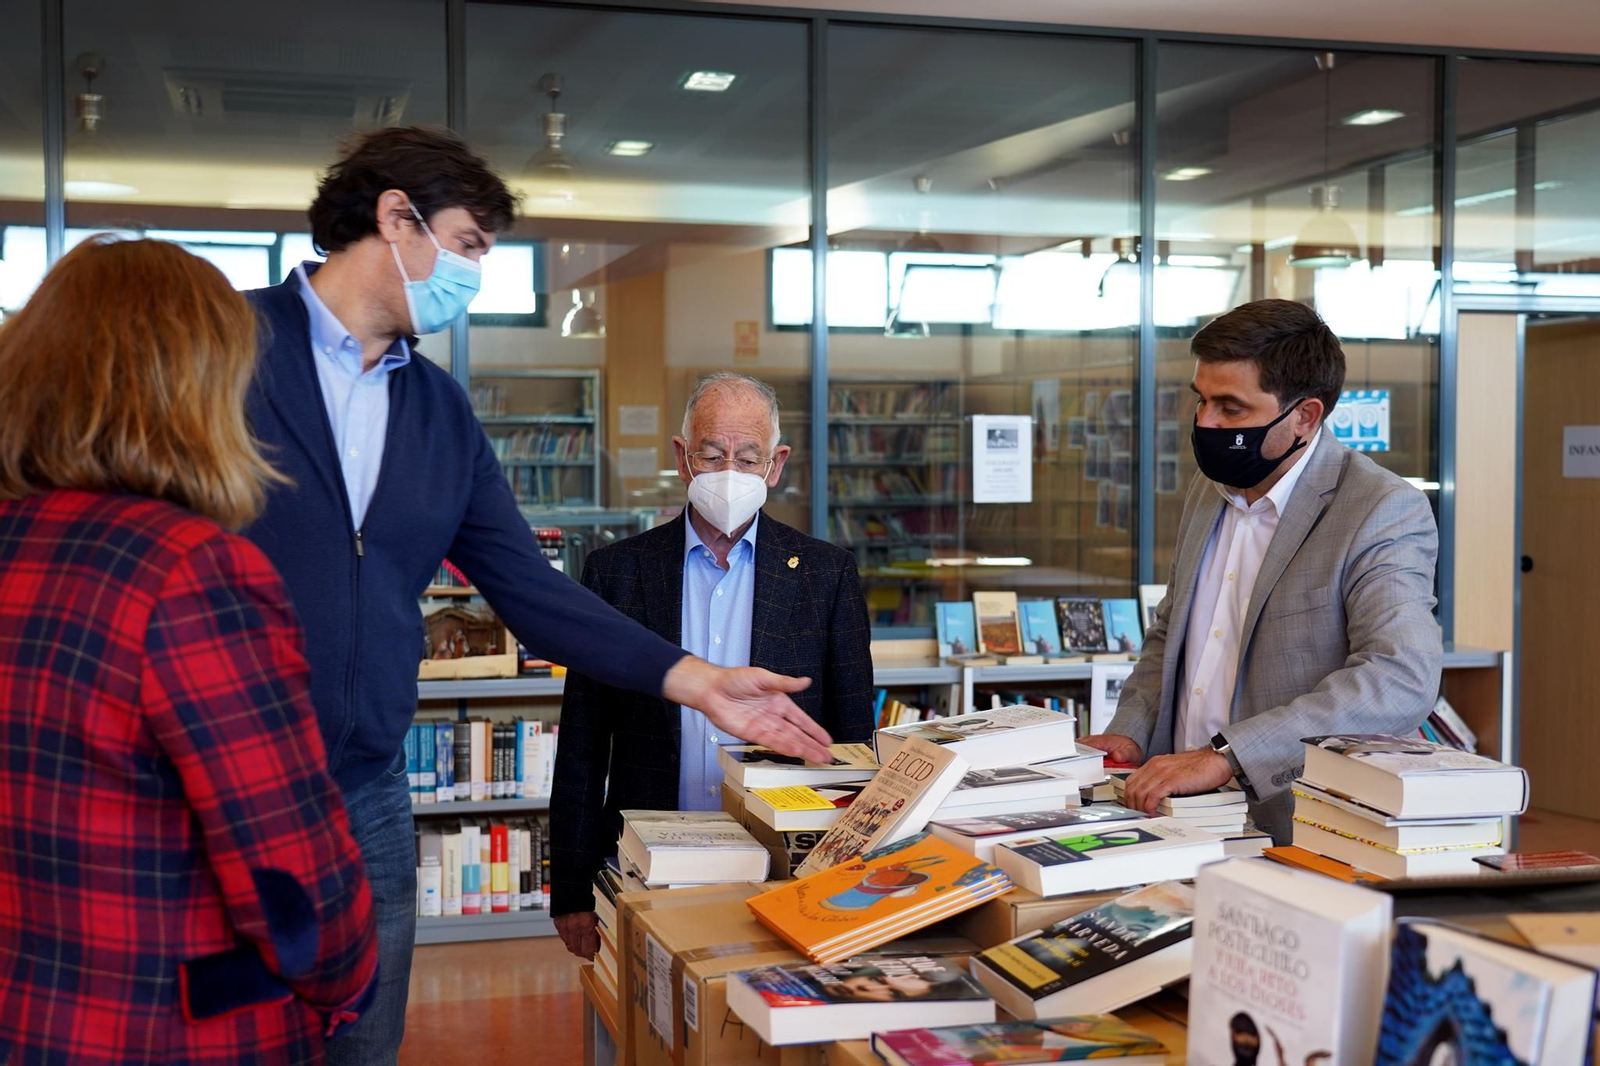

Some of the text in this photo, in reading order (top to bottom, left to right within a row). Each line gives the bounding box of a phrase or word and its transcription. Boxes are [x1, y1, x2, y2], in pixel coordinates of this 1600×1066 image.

[888, 751, 910, 772] EL
[904, 758, 934, 781] CID
[1084, 911, 1145, 948] SANDRA
[1218, 901, 1300, 952] SANTIAGO
[1207, 921, 1311, 981] POSTEGUILLO
[1250, 982, 1306, 1020] DIOSES
